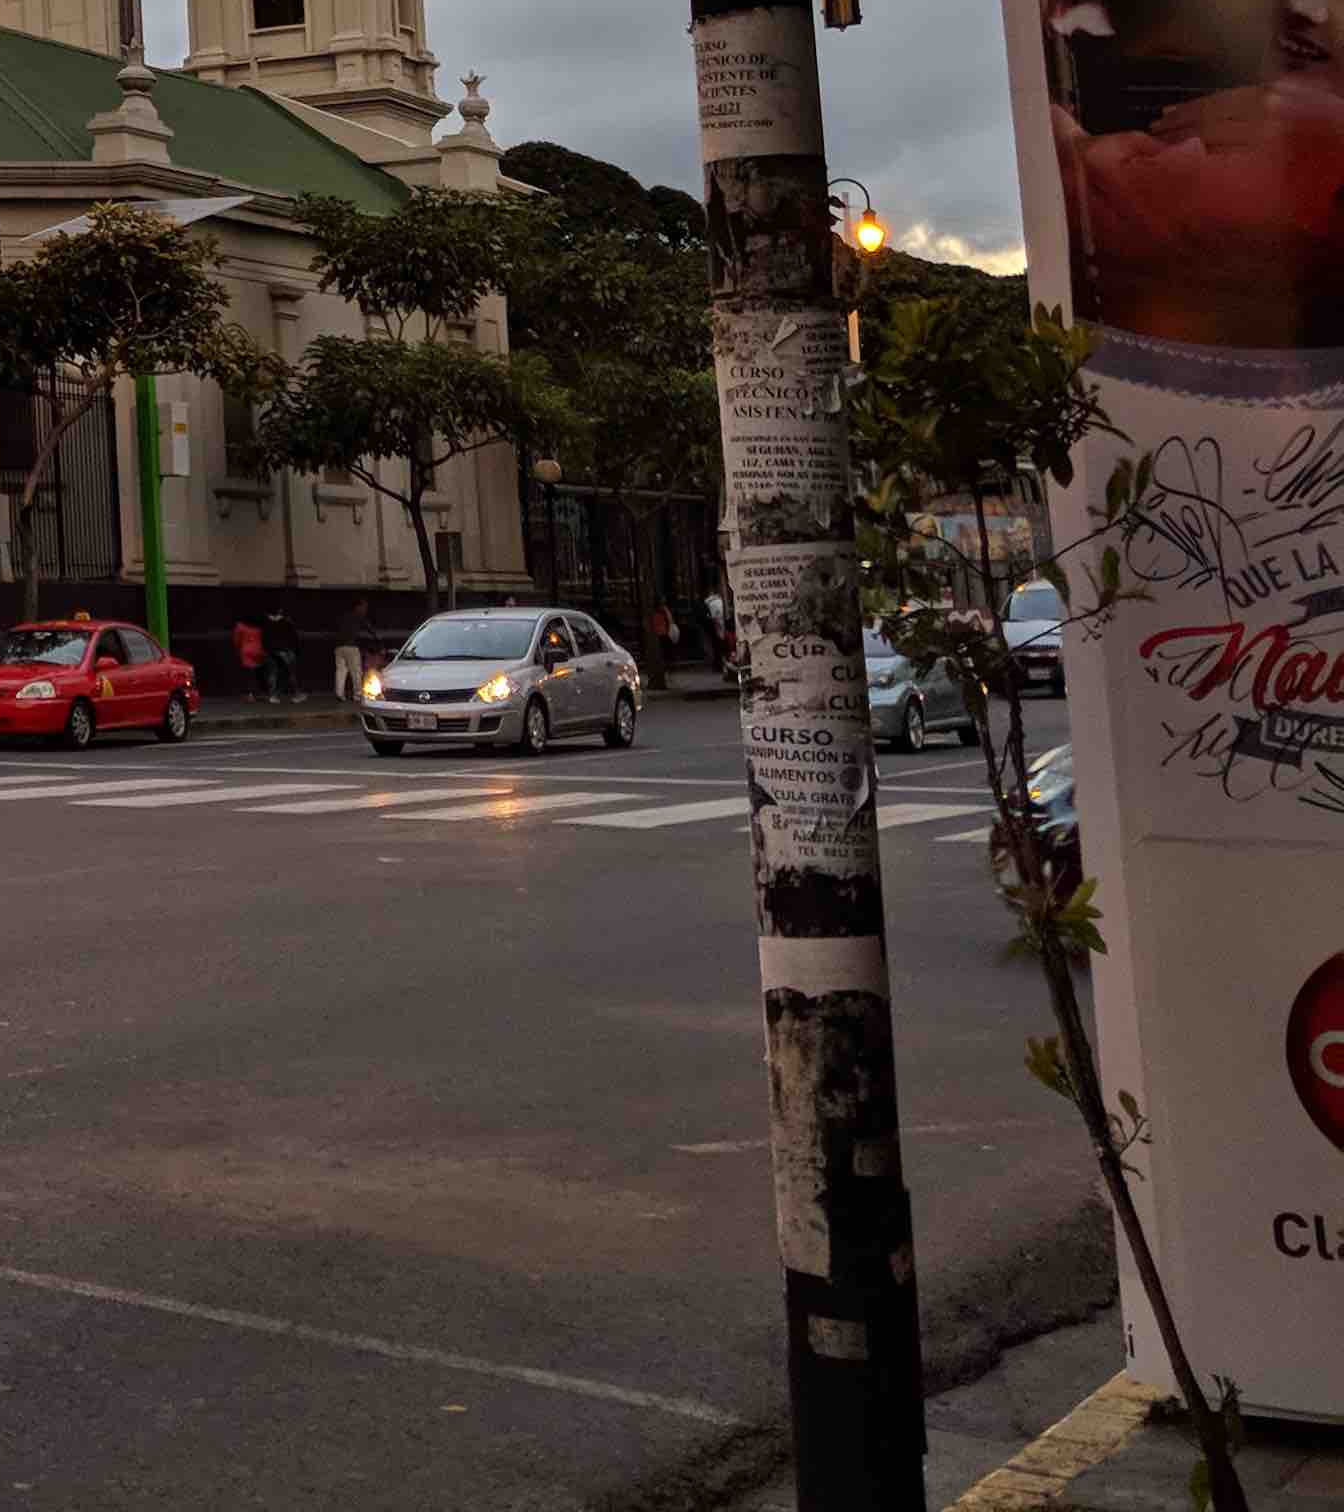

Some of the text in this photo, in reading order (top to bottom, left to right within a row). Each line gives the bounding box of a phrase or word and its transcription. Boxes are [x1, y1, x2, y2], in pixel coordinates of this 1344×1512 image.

[730, 367, 784, 379] CURSO
[1224, 555, 1291, 609] QUE
[751, 728, 833, 746] CURSO
[759, 767, 837, 785] ALIMENTOS
